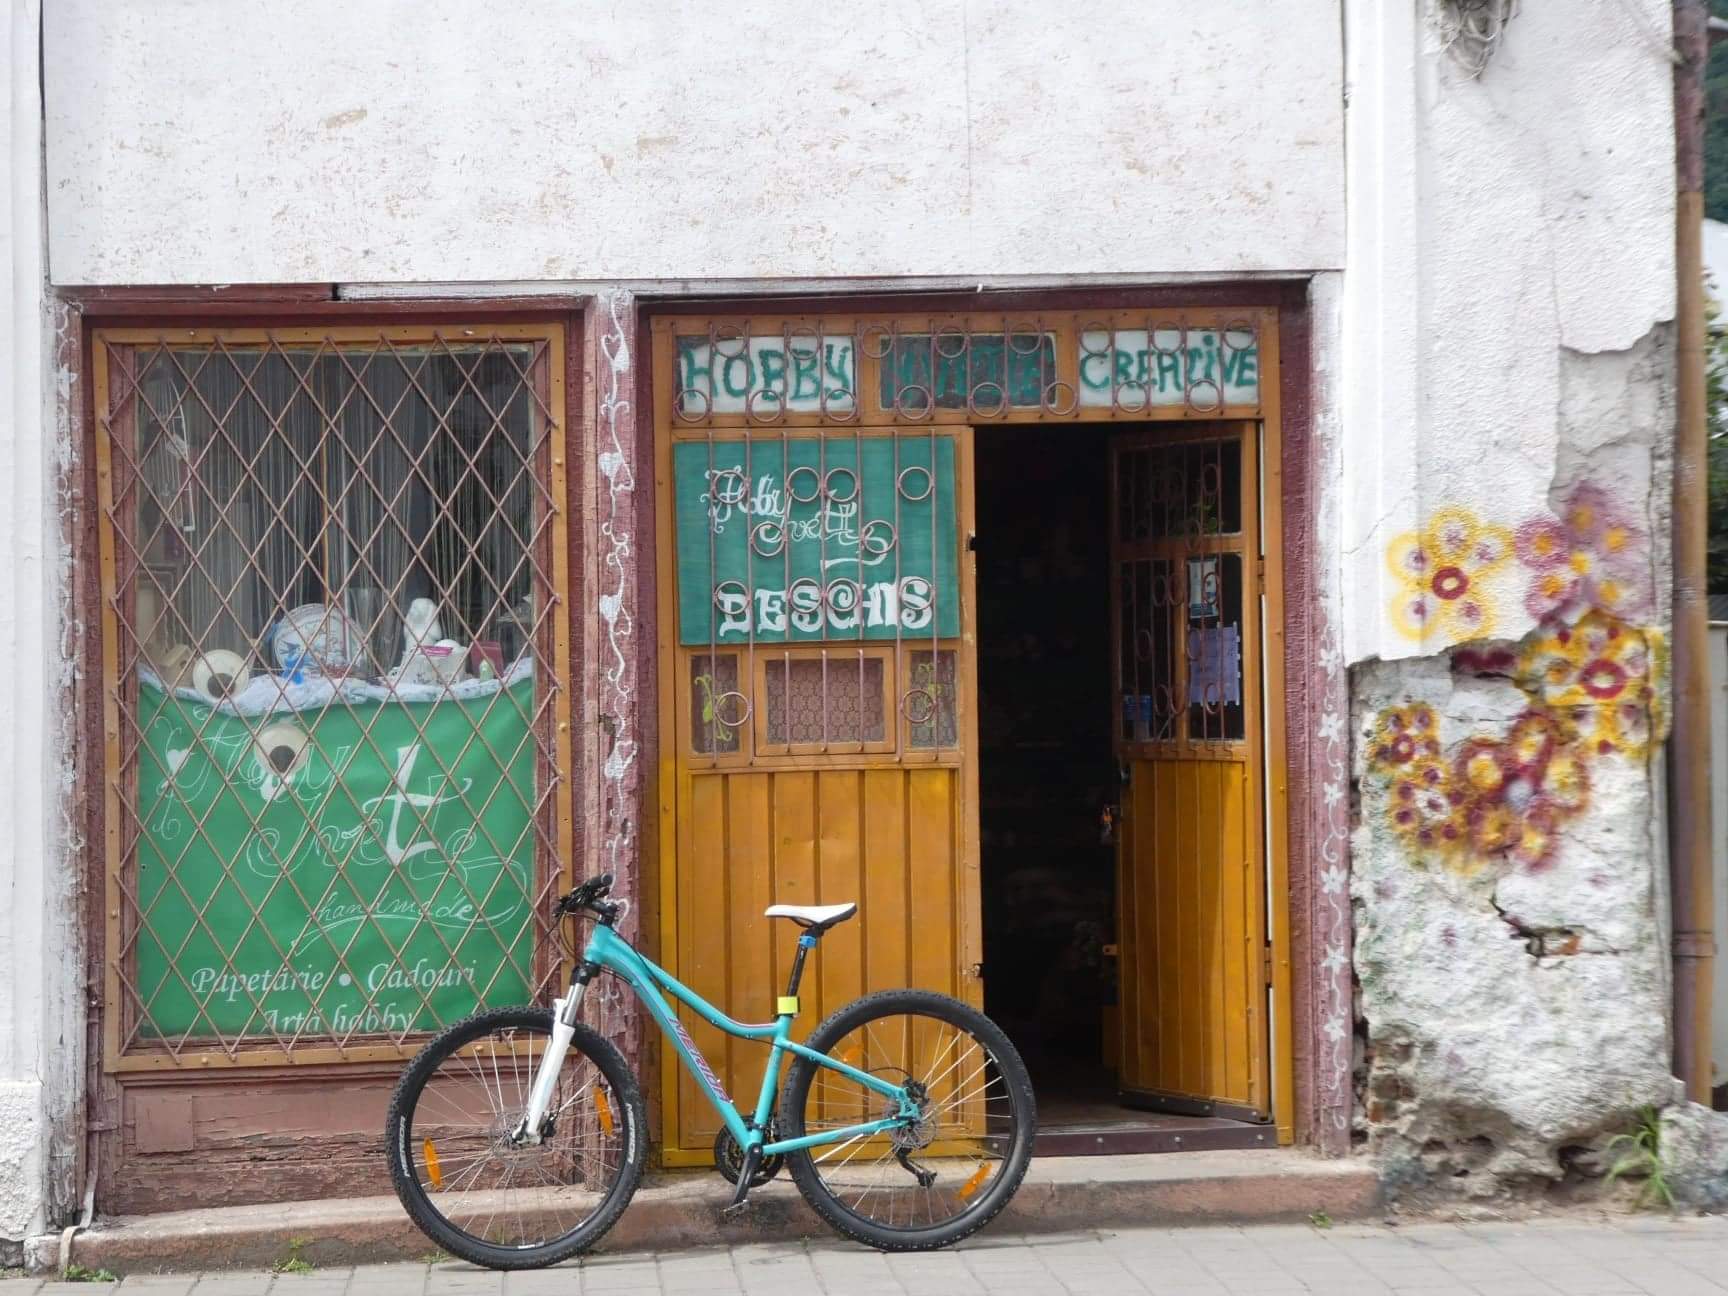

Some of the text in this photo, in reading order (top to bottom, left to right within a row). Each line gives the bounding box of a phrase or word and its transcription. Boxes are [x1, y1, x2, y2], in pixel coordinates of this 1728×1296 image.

[681, 344, 850, 400] HOBBY
[718, 576, 933, 637] DESCHIS
[367, 958, 477, 993] Cadouri
